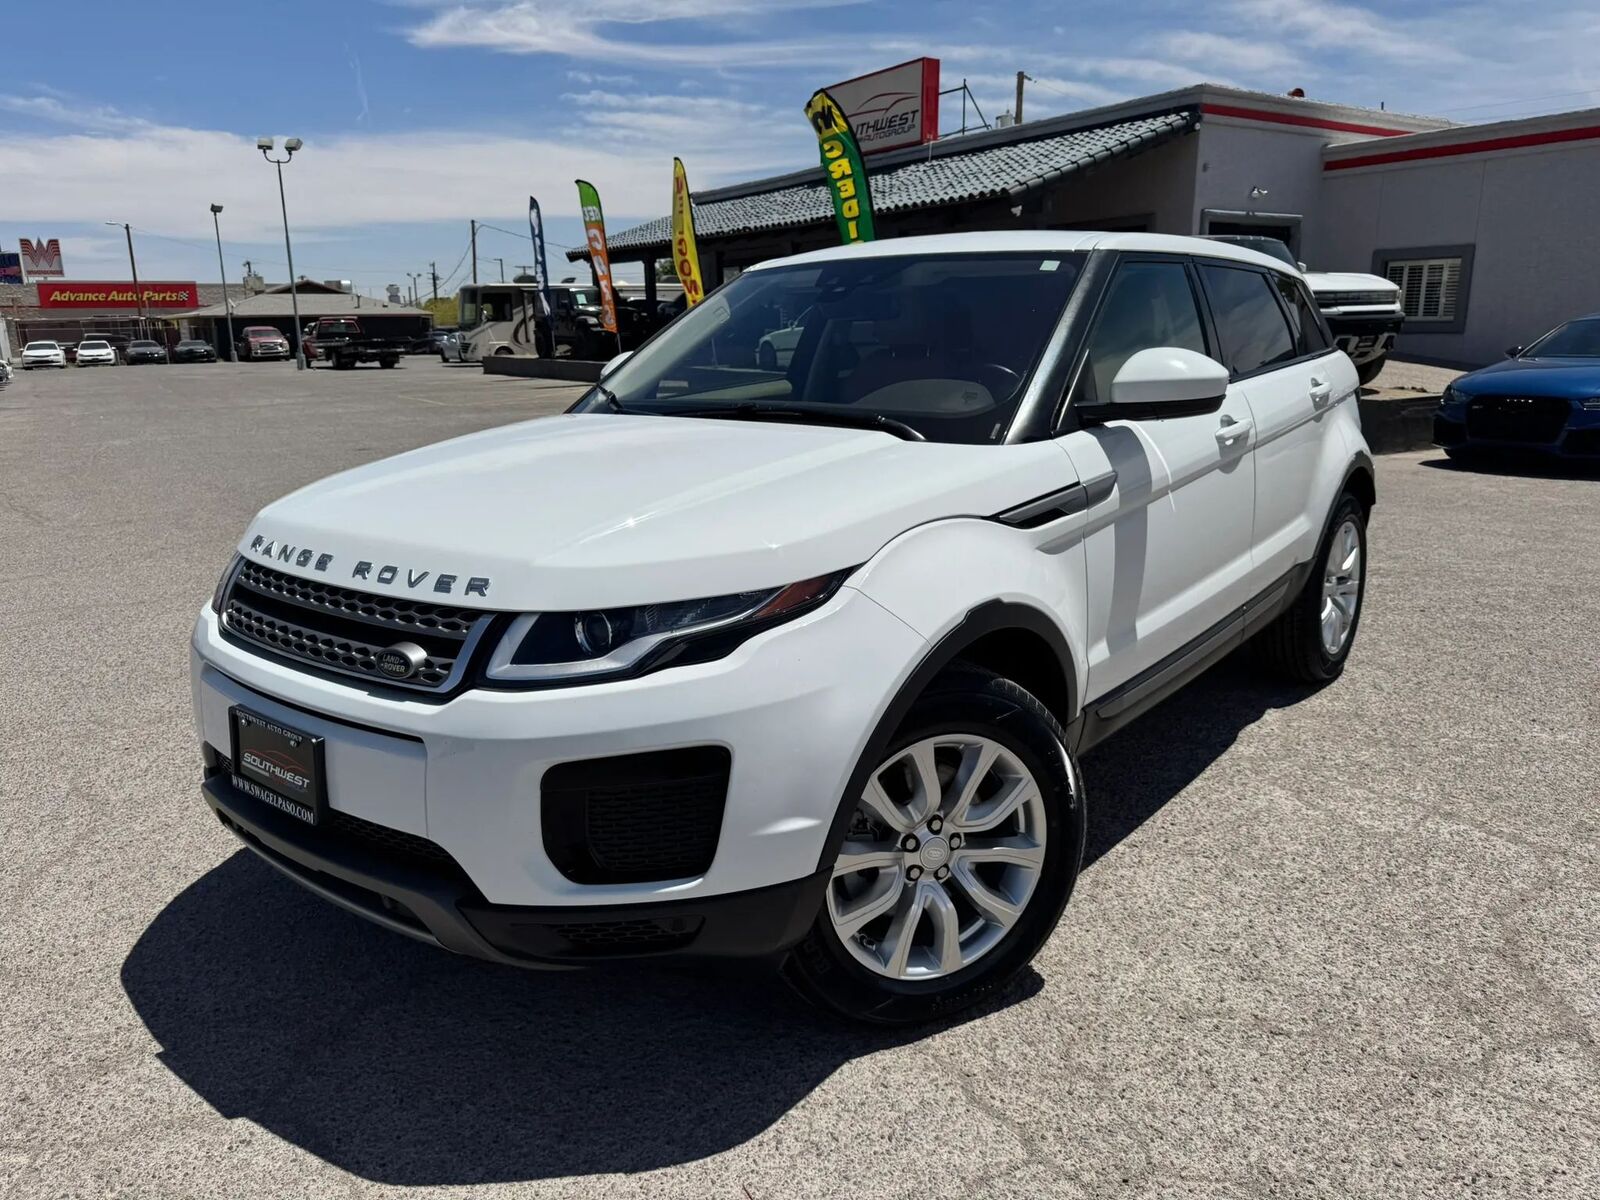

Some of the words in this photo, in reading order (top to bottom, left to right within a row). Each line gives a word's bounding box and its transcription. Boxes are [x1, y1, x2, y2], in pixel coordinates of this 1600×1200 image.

[50, 291, 106, 301] Advance
[107, 291, 140, 301] Auto
[142, 291, 178, 301] Parts
[250, 534, 333, 572] RANGE
[352, 560, 492, 597] ROVER
[382, 653, 400, 664] LAND
[383, 662, 406, 672] ROVER
[243, 752, 310, 788] SOUTHWEST
[231, 774, 314, 824] WWW.SWAGELPASO.COM
